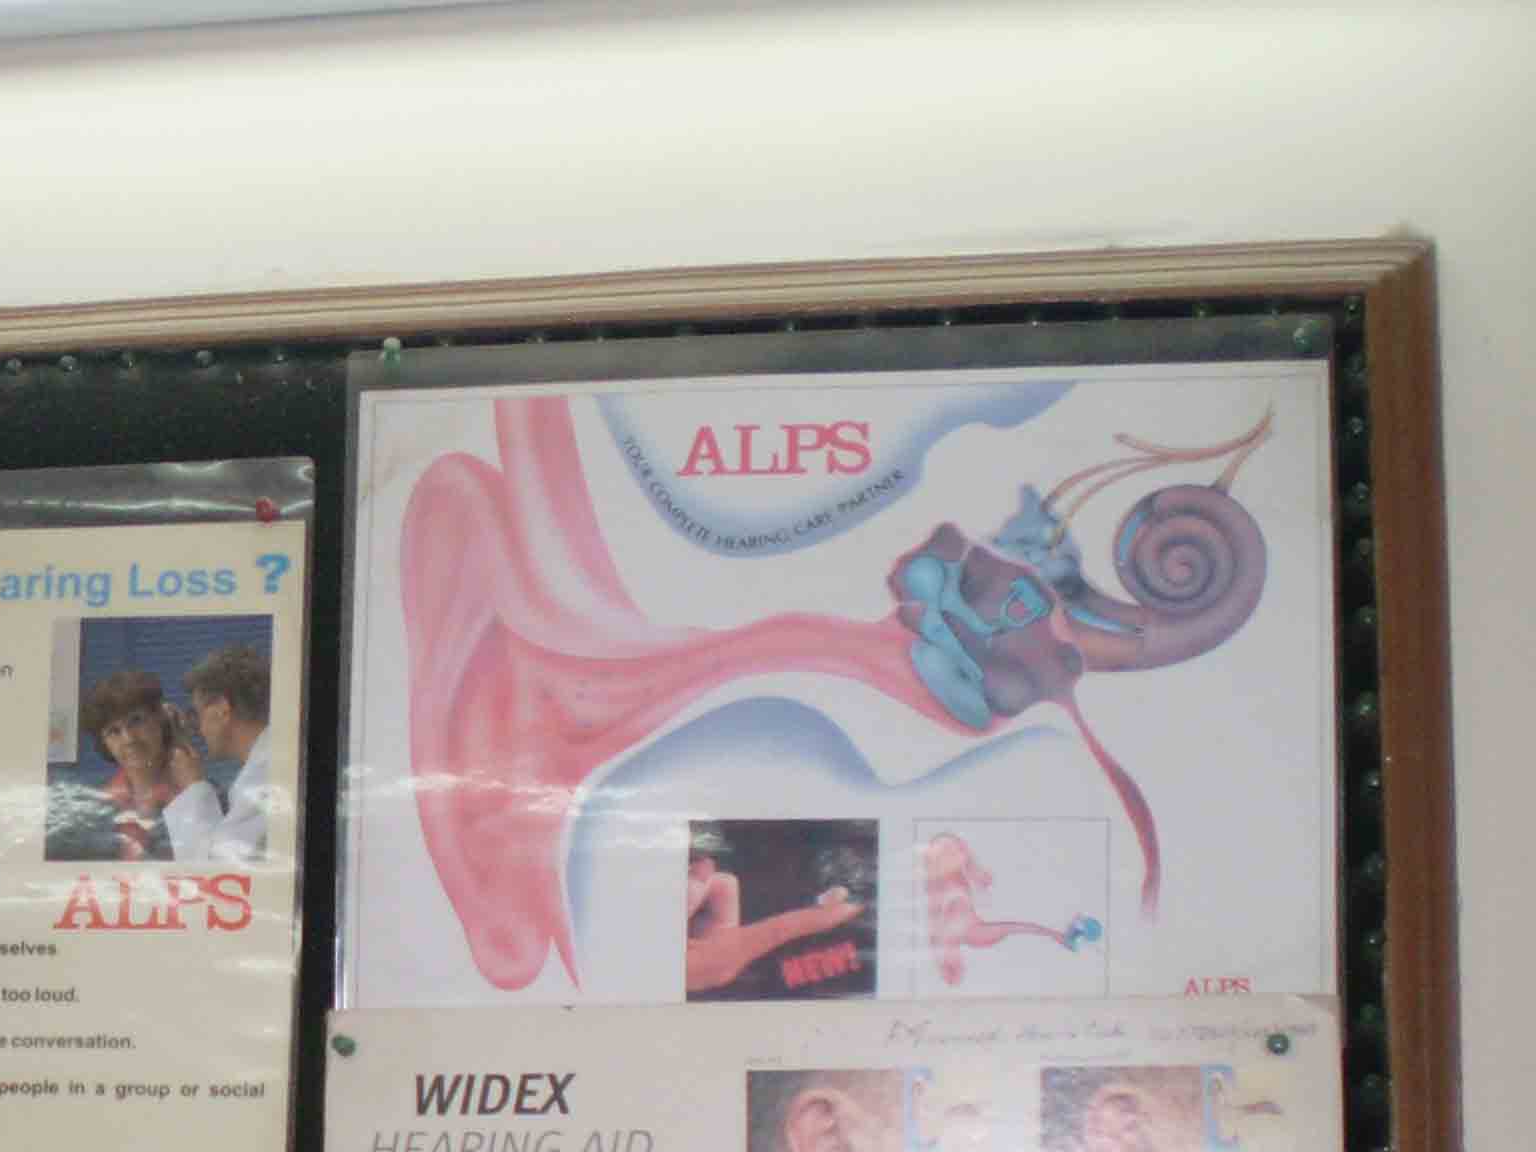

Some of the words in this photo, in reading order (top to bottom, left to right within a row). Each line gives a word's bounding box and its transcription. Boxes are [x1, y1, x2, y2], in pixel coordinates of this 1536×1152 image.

[676, 421, 872, 477] ALPS
[128, 562, 237, 598] Loss
[255, 553, 291, 594] ?
[53, 873, 253, 931] ALPS
[1, 988, 32, 1002] too
[34, 987, 80, 1002] loud.
[11, 1034, 136, 1050] conversation.
[69, 1080, 85, 1095] in
[95, 1084, 106, 1096] a
[115, 1083, 170, 1099] group
[181, 1084, 199, 1096] or
[210, 1081, 264, 1097] social
[416, 1073, 575, 1116] WIDEX
